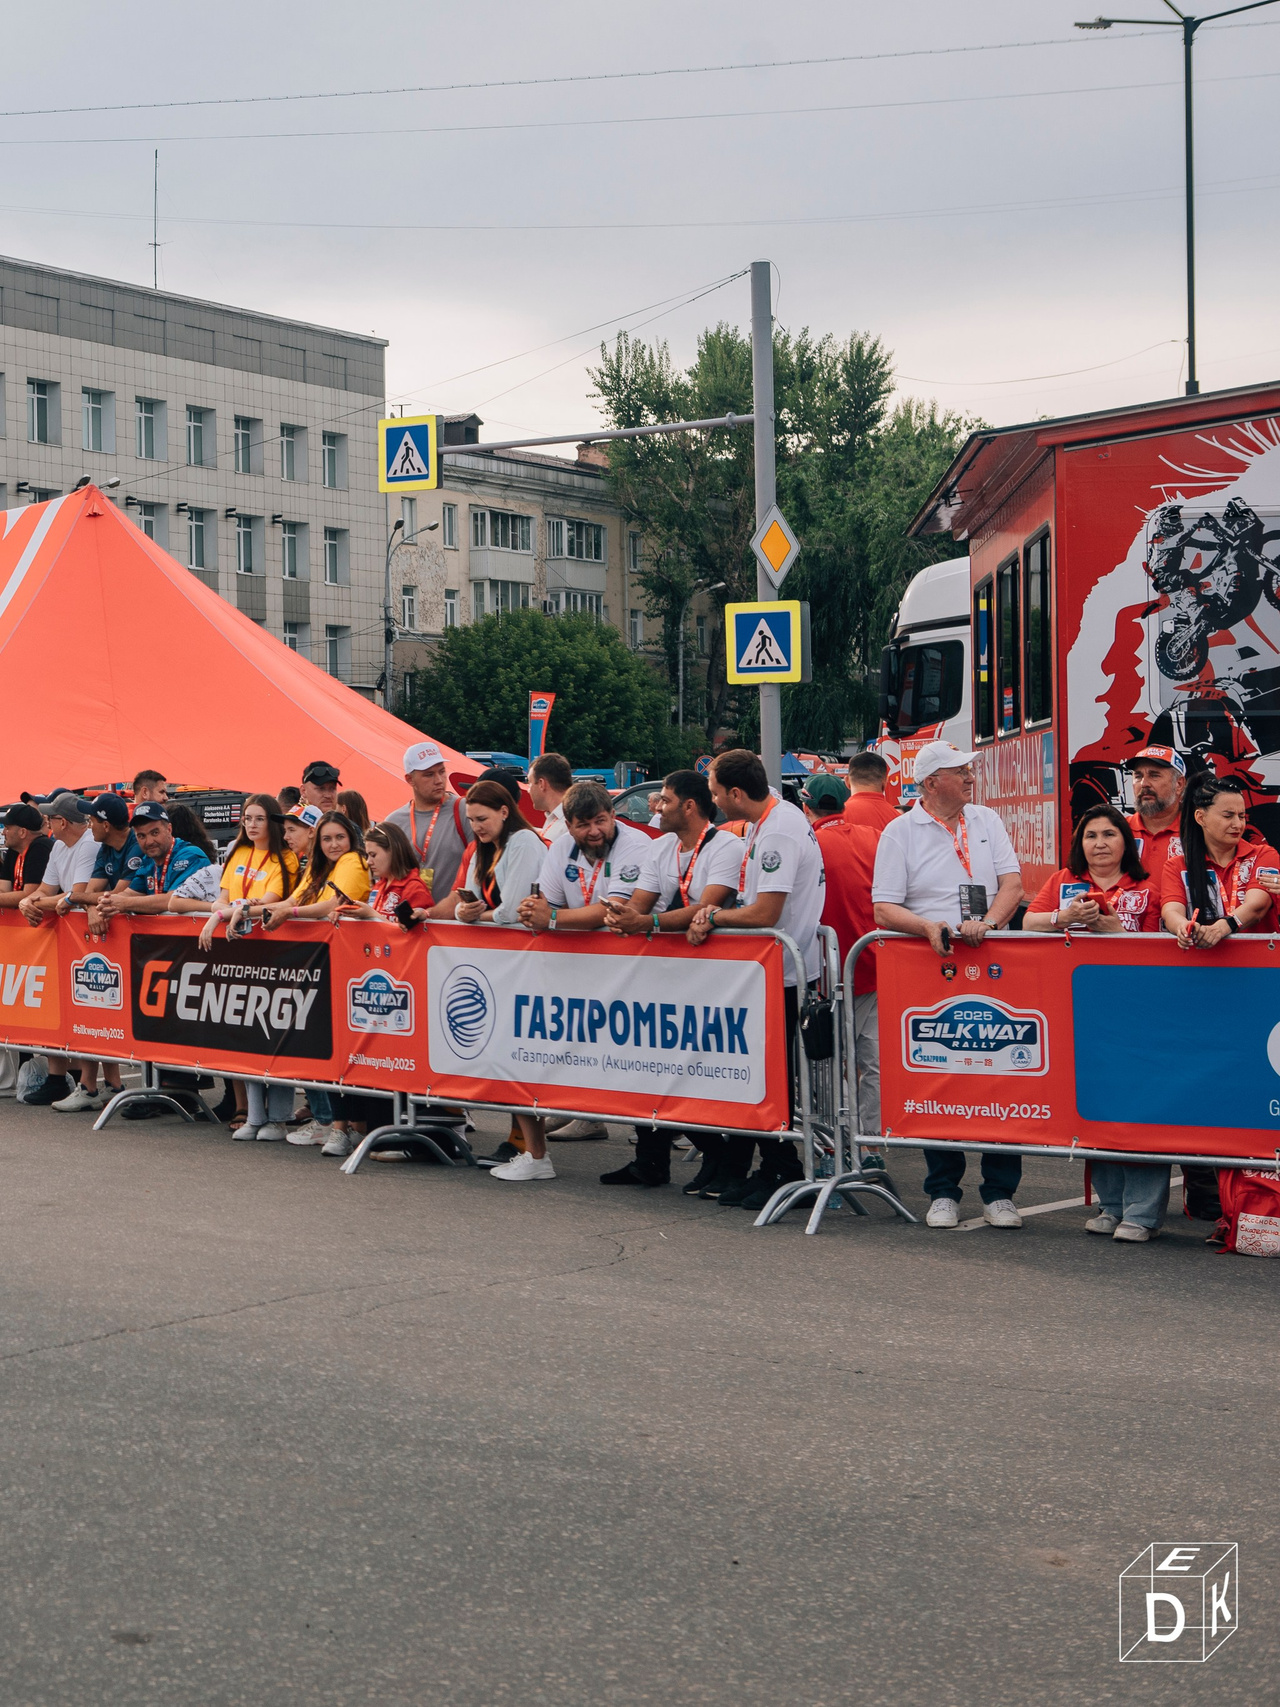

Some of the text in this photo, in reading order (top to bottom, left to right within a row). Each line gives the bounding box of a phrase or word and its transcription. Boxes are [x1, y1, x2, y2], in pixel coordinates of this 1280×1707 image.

[985, 744, 1001, 800] SILK
[1015, 734, 1042, 797] RALLY
[1118, 913, 1139, 922] SIL
[88, 963, 105, 971] 2025
[211, 963, 321, 982] МОТОРНОЕ МАСЛО
[77, 970, 117, 985] SILK WAY
[369, 981, 387, 991] 2025
[354, 990, 406, 1007] SILK WAY
[953, 1010, 993, 1021] 2025
[73, 1024, 125, 1040] #silkwayrally2025
[513, 994, 749, 1055] ГАЗПРОМБАНК
[917, 1022, 1031, 1041] SILK WAY
[952, 1041, 996, 1049] RALLY
[348, 1053, 416, 1071] #silkwayrally2025
[511, 1047, 752, 1084] «Газпромбанк» (Акционерное общество)
[922, 1055, 948, 1063] GAZPROM
[904, 1099, 1052, 1121] #silkwayrally2025
